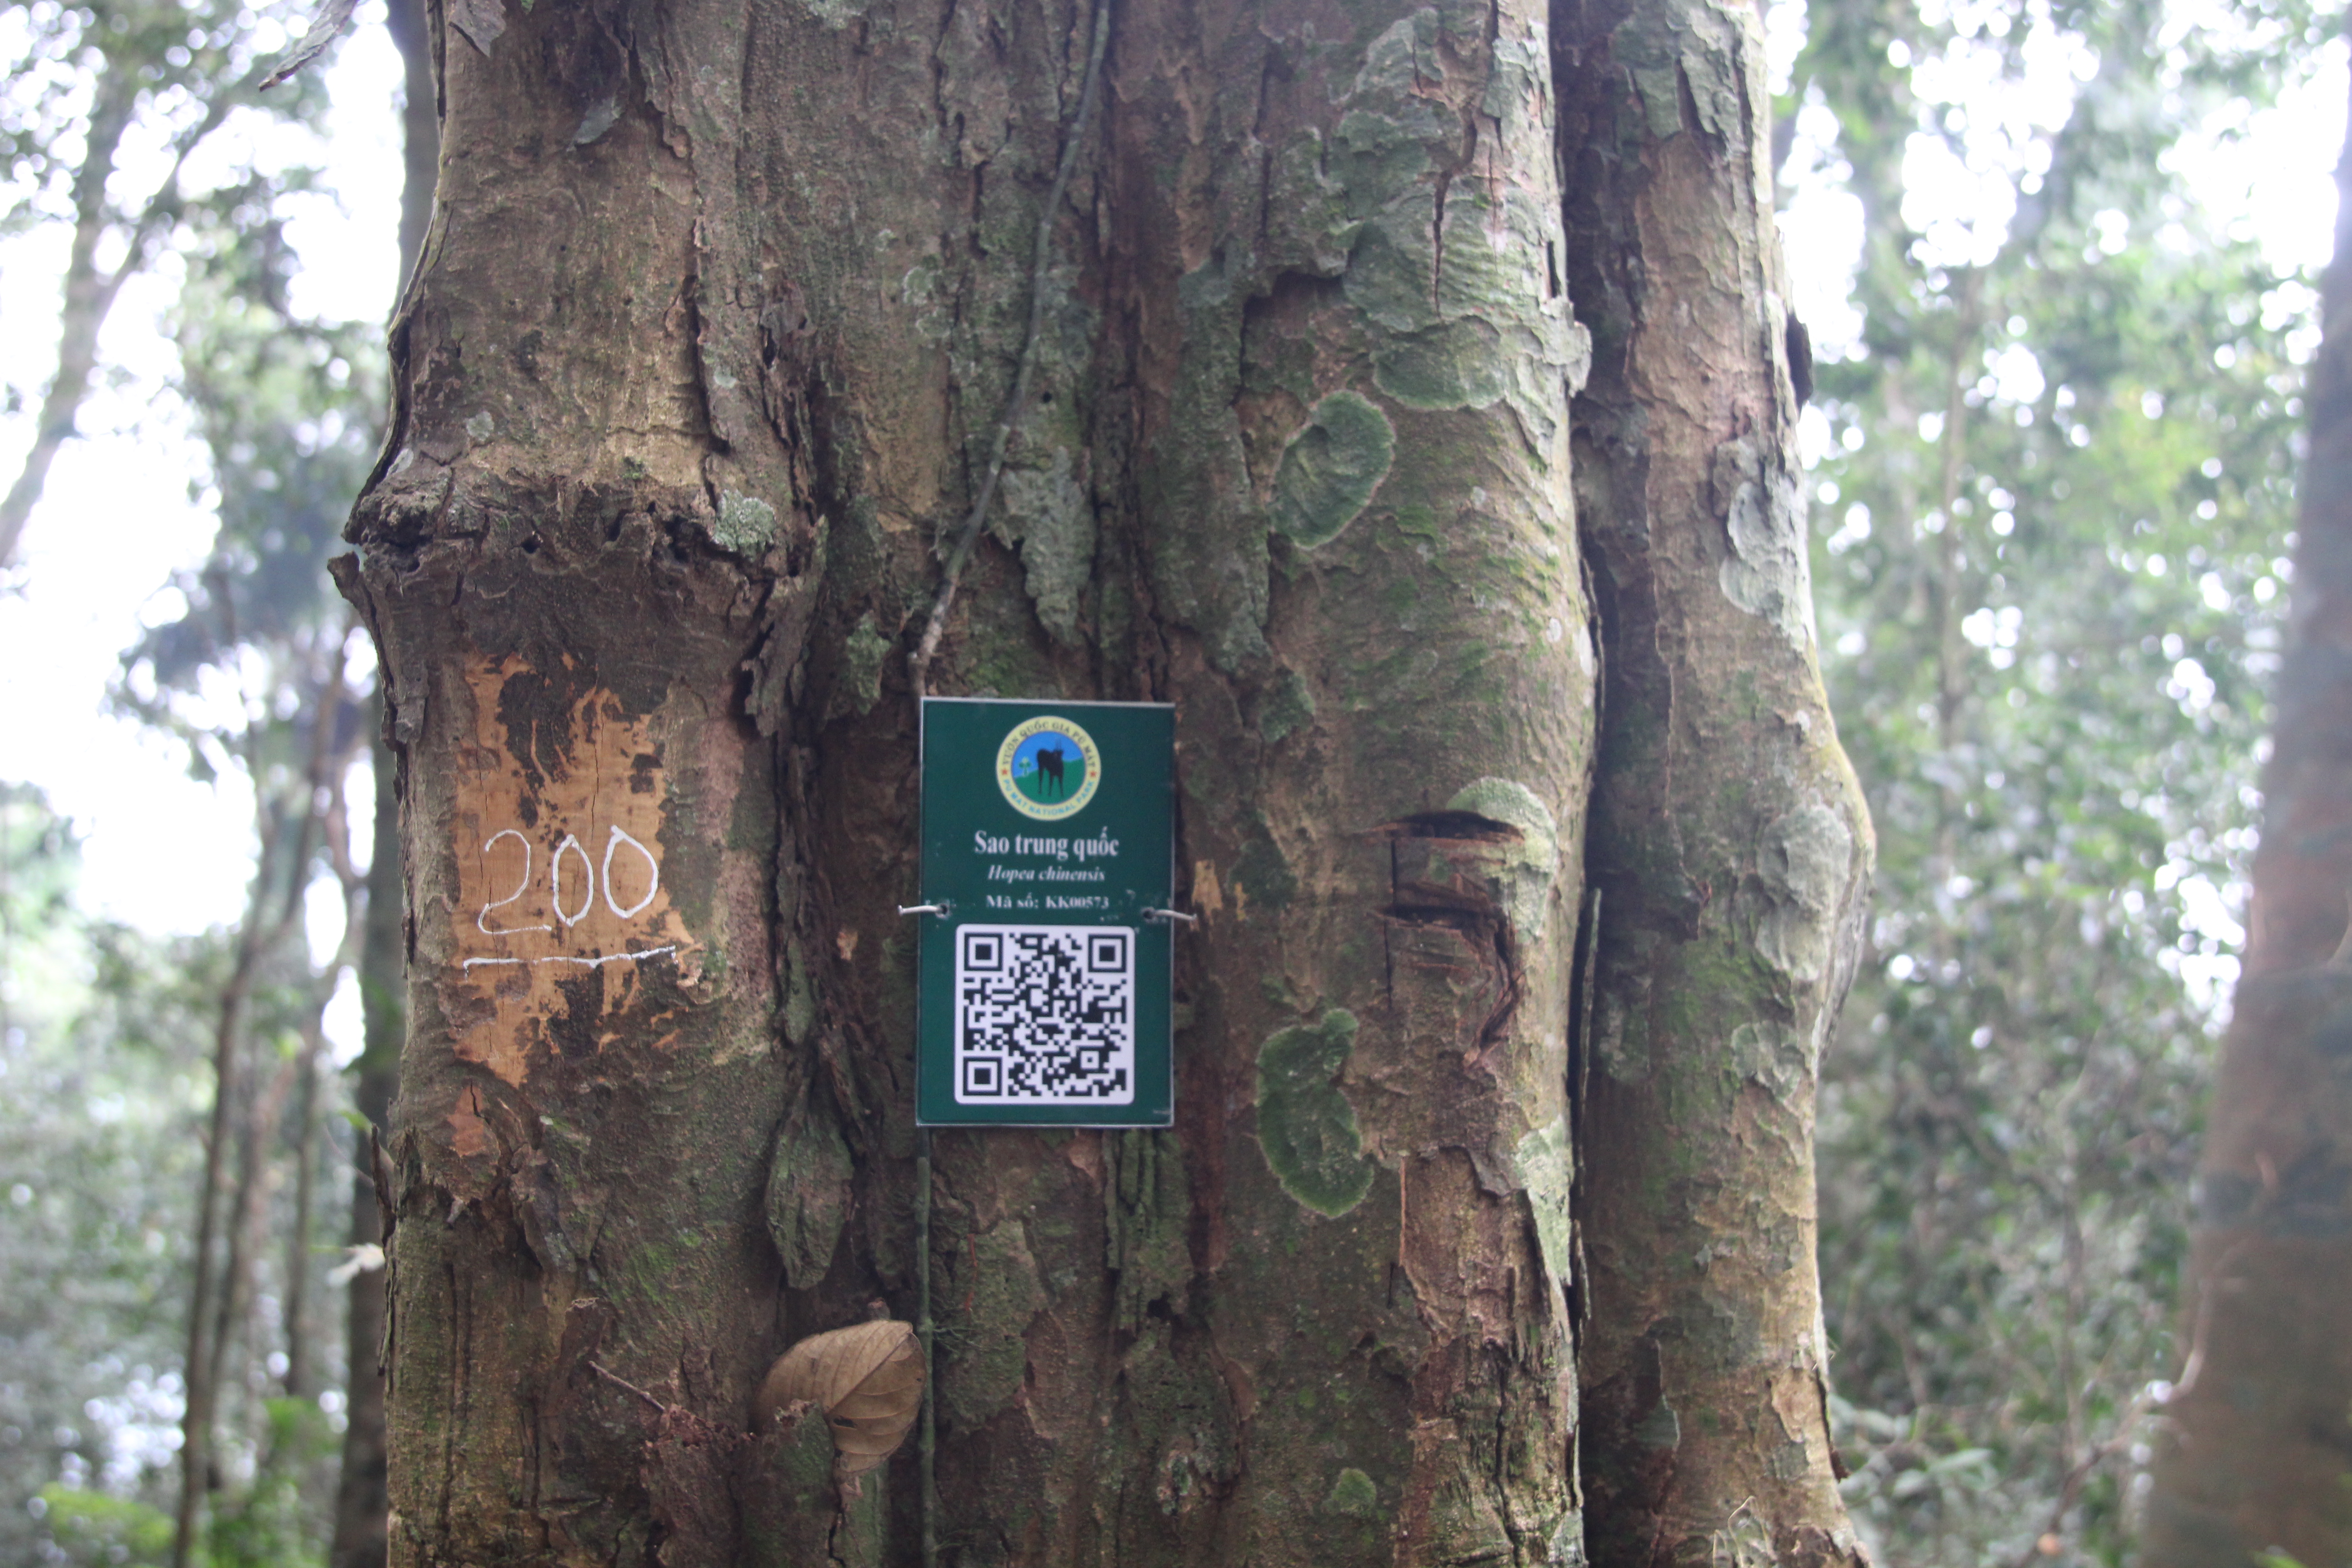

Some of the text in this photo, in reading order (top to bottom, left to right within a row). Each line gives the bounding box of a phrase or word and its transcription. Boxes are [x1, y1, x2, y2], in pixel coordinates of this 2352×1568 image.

[1052, 722, 1070, 734] GIA
[1011, 792, 1026, 808] MAT
[1029, 804, 1076, 816] NATIONAL
[1076, 781, 1095, 804] PARK
[974, 826, 1120, 862] Sao trung quốc
[478, 824, 659, 935] 200
[987, 864, 1106, 884] Hopea chinensis
[986, 892, 1109, 909] Mã số: KK00573
